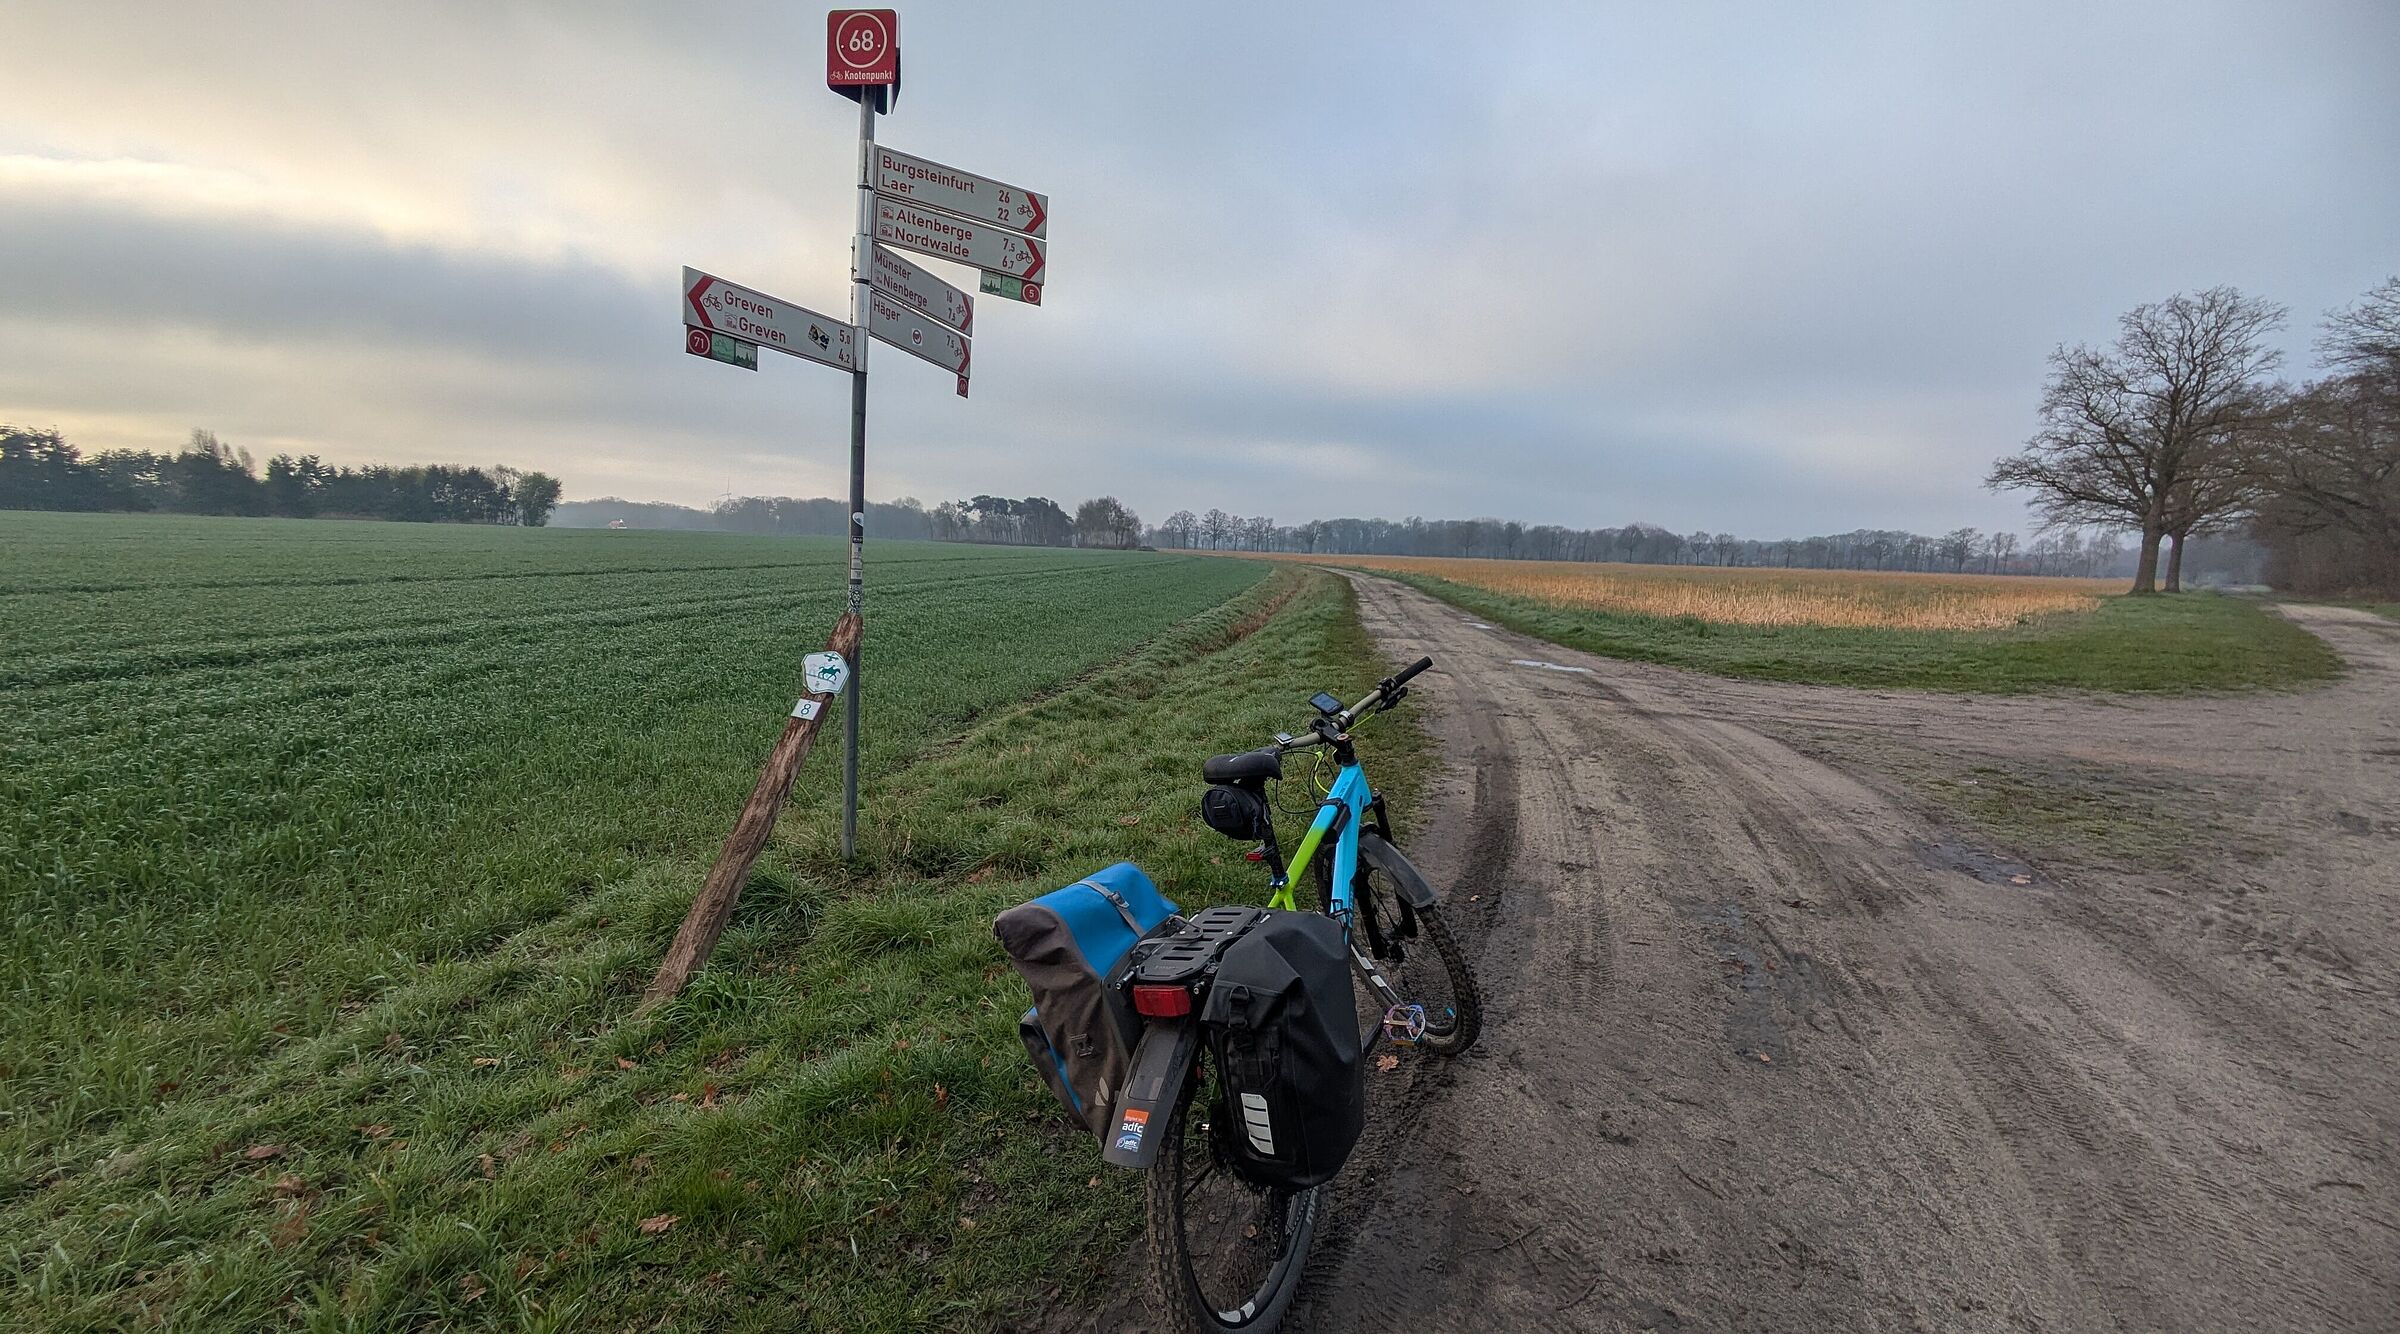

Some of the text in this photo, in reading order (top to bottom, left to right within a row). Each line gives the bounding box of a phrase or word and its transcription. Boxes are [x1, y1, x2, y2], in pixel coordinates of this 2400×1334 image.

[849, 29, 873, 51] 68
[845, 70, 892, 82] Knotenpunkt
[882, 155, 1010, 204] Burgsteinfurt 26
[881, 173, 1009, 221] Laer 22
[895, 227, 969, 257] Nordwalde
[896, 209, 1015, 252] Altenberge 7,5
[874, 251, 953, 303] Münster 16
[883, 274, 928, 307] Nienberge
[724, 290, 773, 319] Greven
[1029, 289, 1034, 297] 5
[873, 298, 901, 322] Häger
[694, 337, 704, 349] 71
[738, 316, 786, 344] Greven
[801, 703, 811, 715] 8
[1122, 1122, 1143, 1133] adfc
